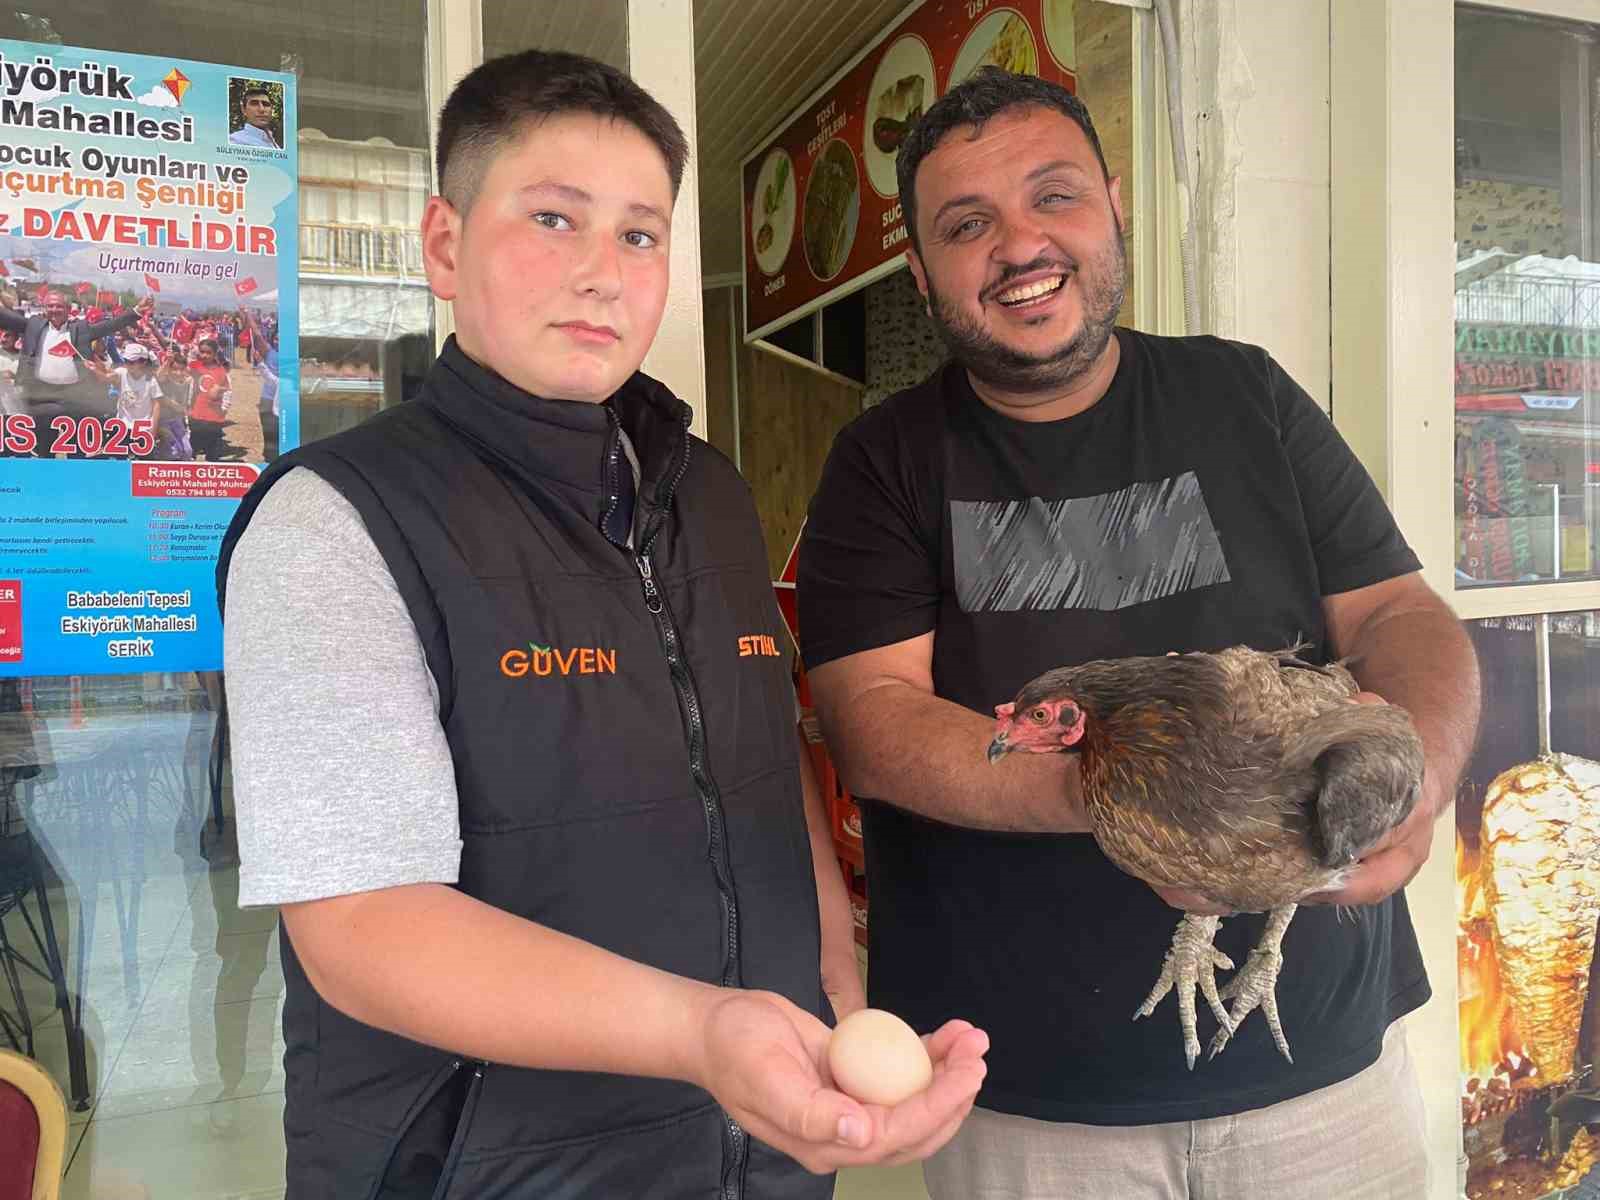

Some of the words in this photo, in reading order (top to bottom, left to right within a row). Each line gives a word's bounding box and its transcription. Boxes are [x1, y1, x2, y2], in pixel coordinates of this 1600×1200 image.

[0, 54, 133, 99] yörük
[2, 100, 194, 142] Mahallesi
[82, 148, 206, 181] Oyunları
[216, 165, 248, 184] ve
[0, 170, 125, 200] çurtma
[137, 177, 244, 214] Şenliği
[23, 207, 277, 256] DAVETLİDİR
[99, 255, 180, 274] Uçurtmanı
[184, 261, 210, 278] kap
[215, 262, 238, 280] gel
[51, 416, 155, 455] 2025
[138, 479, 180, 488] Eskiyörük
[183, 480, 219, 488] Mahalle
[148, 467, 192, 478] Ramis
[196, 466, 244, 480] GÜZEL
[68, 592, 143, 607] Bababeleni
[148, 591, 189, 607] Tepesi
[62, 617, 130, 635] Eskiyörük
[134, 617, 196, 631] Mahallesi
[109, 640, 153, 657] SERİK
[500, 643, 617, 677] GÜVEN
[737, 634, 780, 657] STIHL
